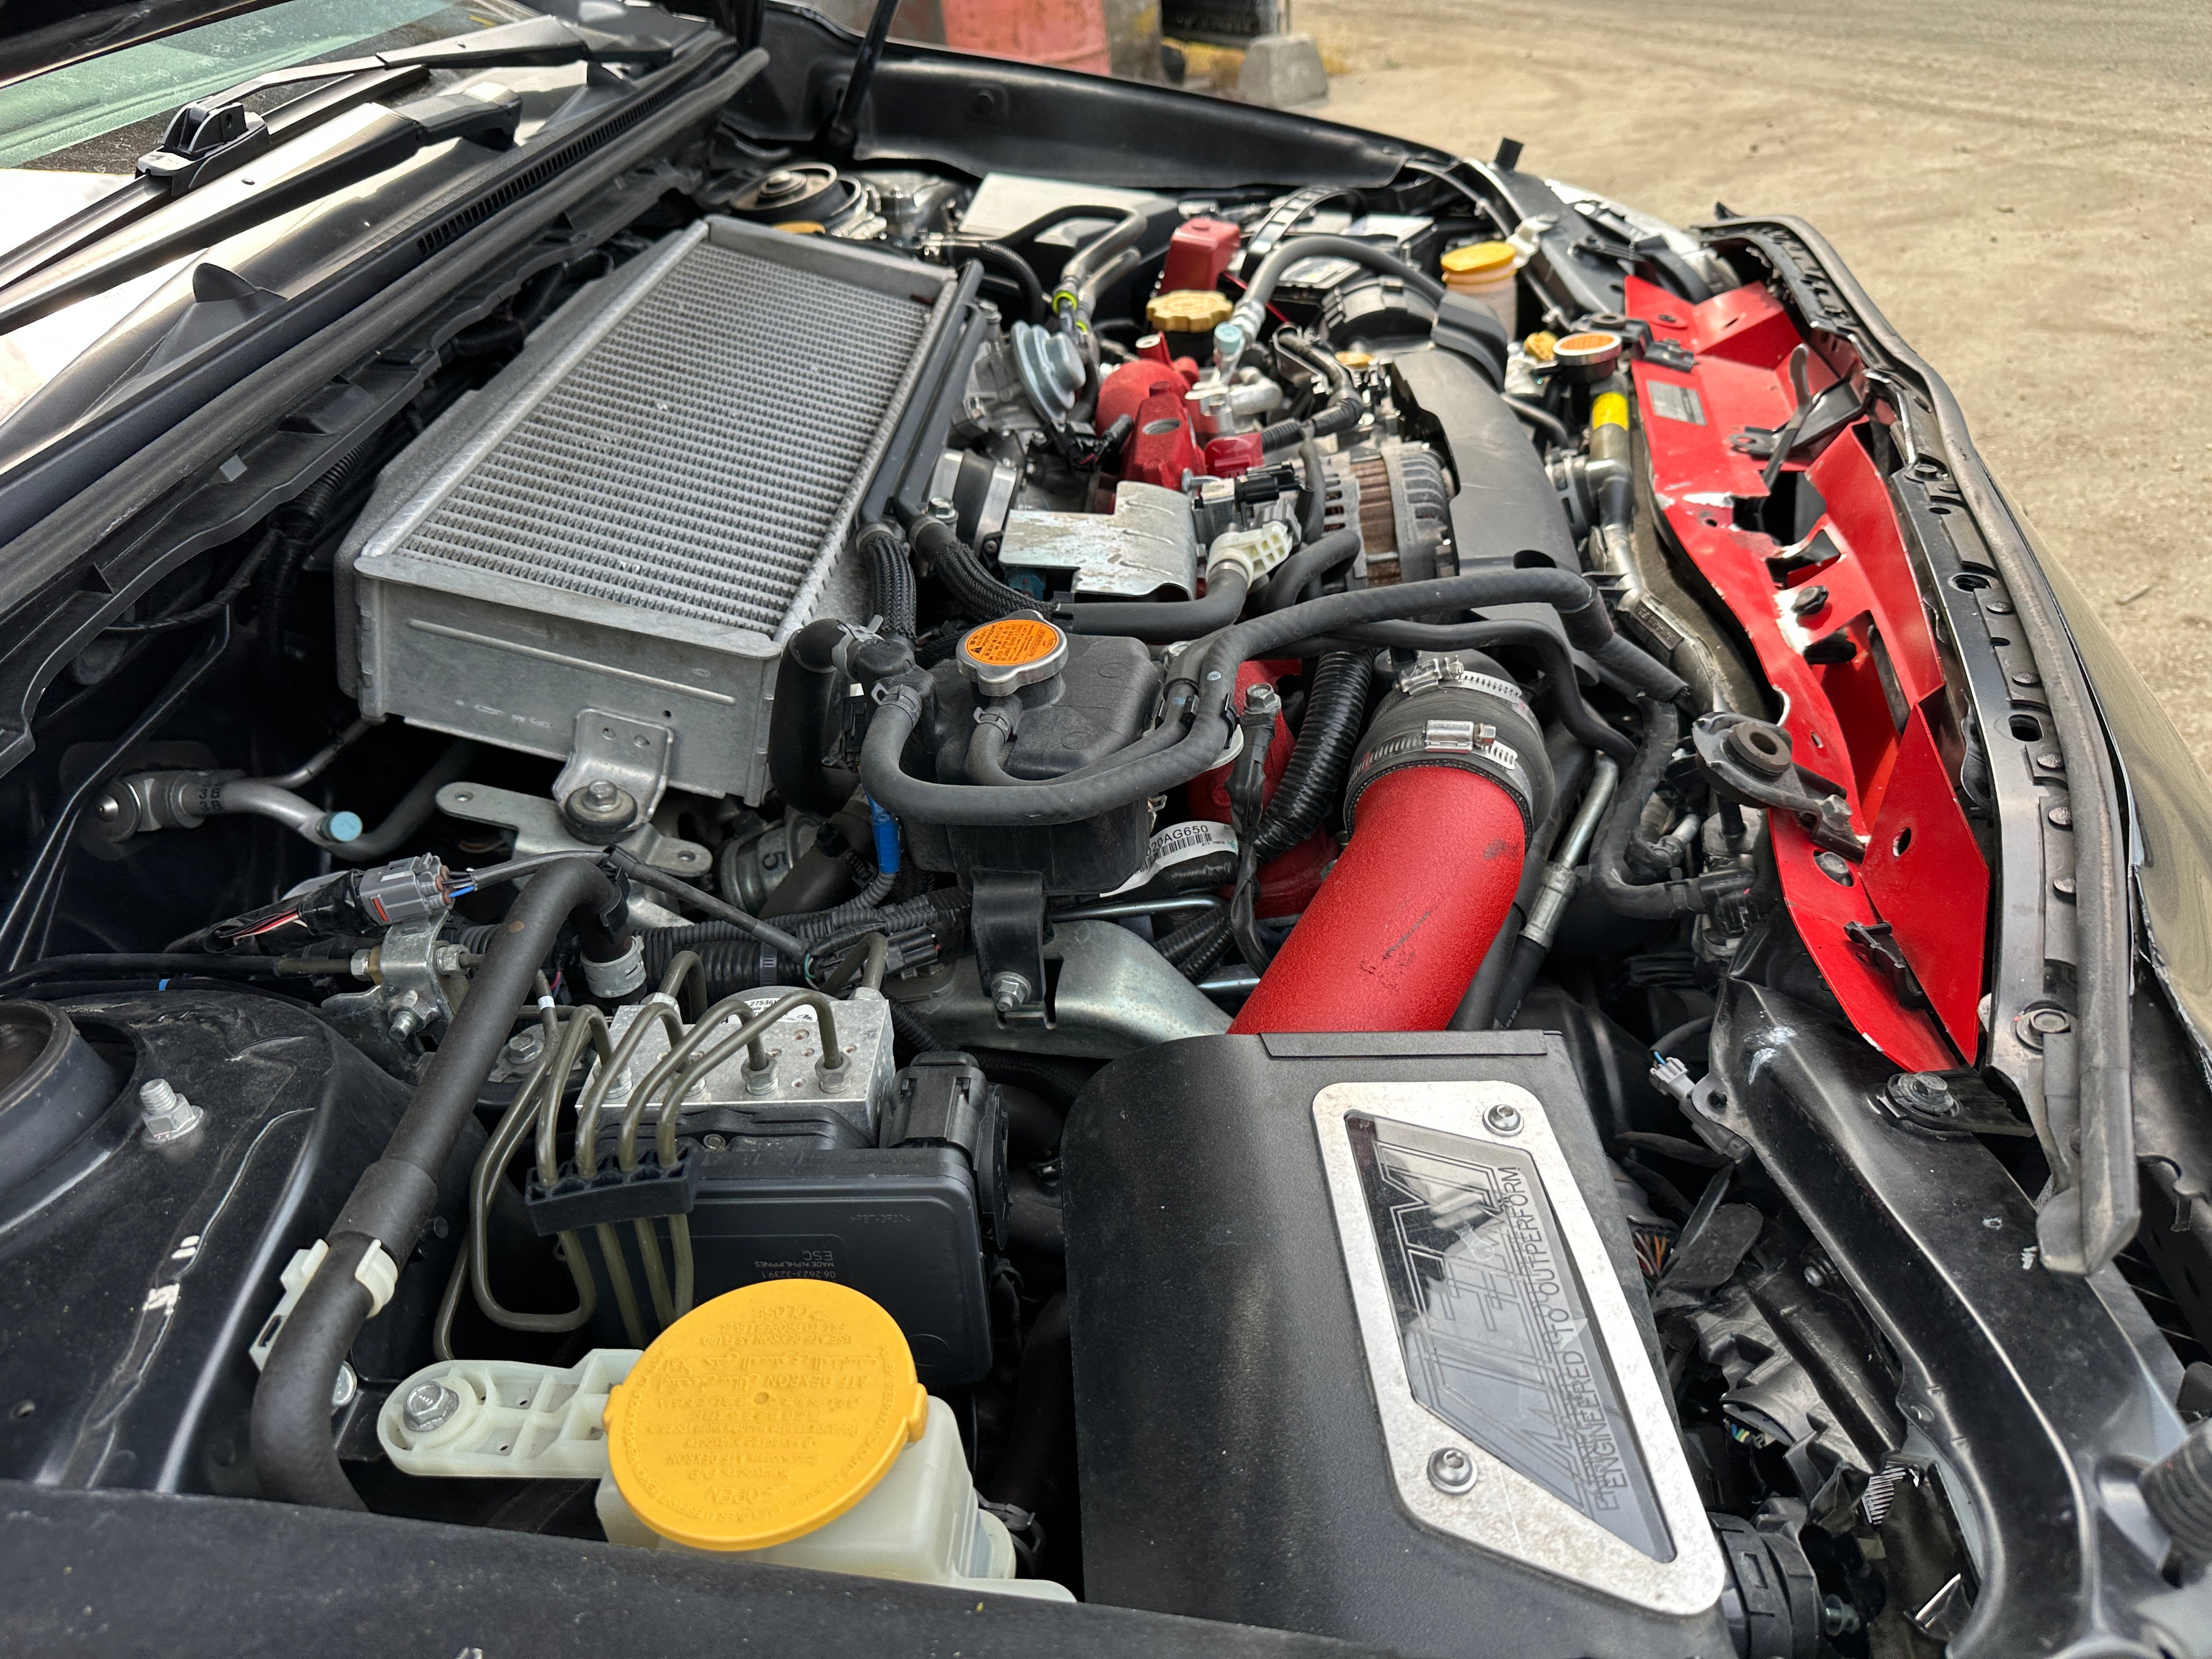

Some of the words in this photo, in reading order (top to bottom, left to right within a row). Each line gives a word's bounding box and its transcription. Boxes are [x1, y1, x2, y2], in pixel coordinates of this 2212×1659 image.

[1026, 630, 1047, 656] AVERTISSEMENT
[801, 1249, 833, 1261] ESC
[752, 1303, 811, 1319] CLOSE
[720, 1323, 754, 1333] LEVEL
[756, 1322, 803, 1333] PROPER
[805, 1322, 819, 1332] TO
[824, 1321, 846, 1332] FILL
[702, 1335, 736, 1346] FLUID
[738, 1334, 752, 1346] AS
[756, 1334, 804, 1344] DEXRON
[829, 1334, 853, 1344] USE
[766, 1374, 833, 1387] DEXRON
[838, 1374, 869, 1387] ATF
[706, 1486, 760, 1503] OPEN
